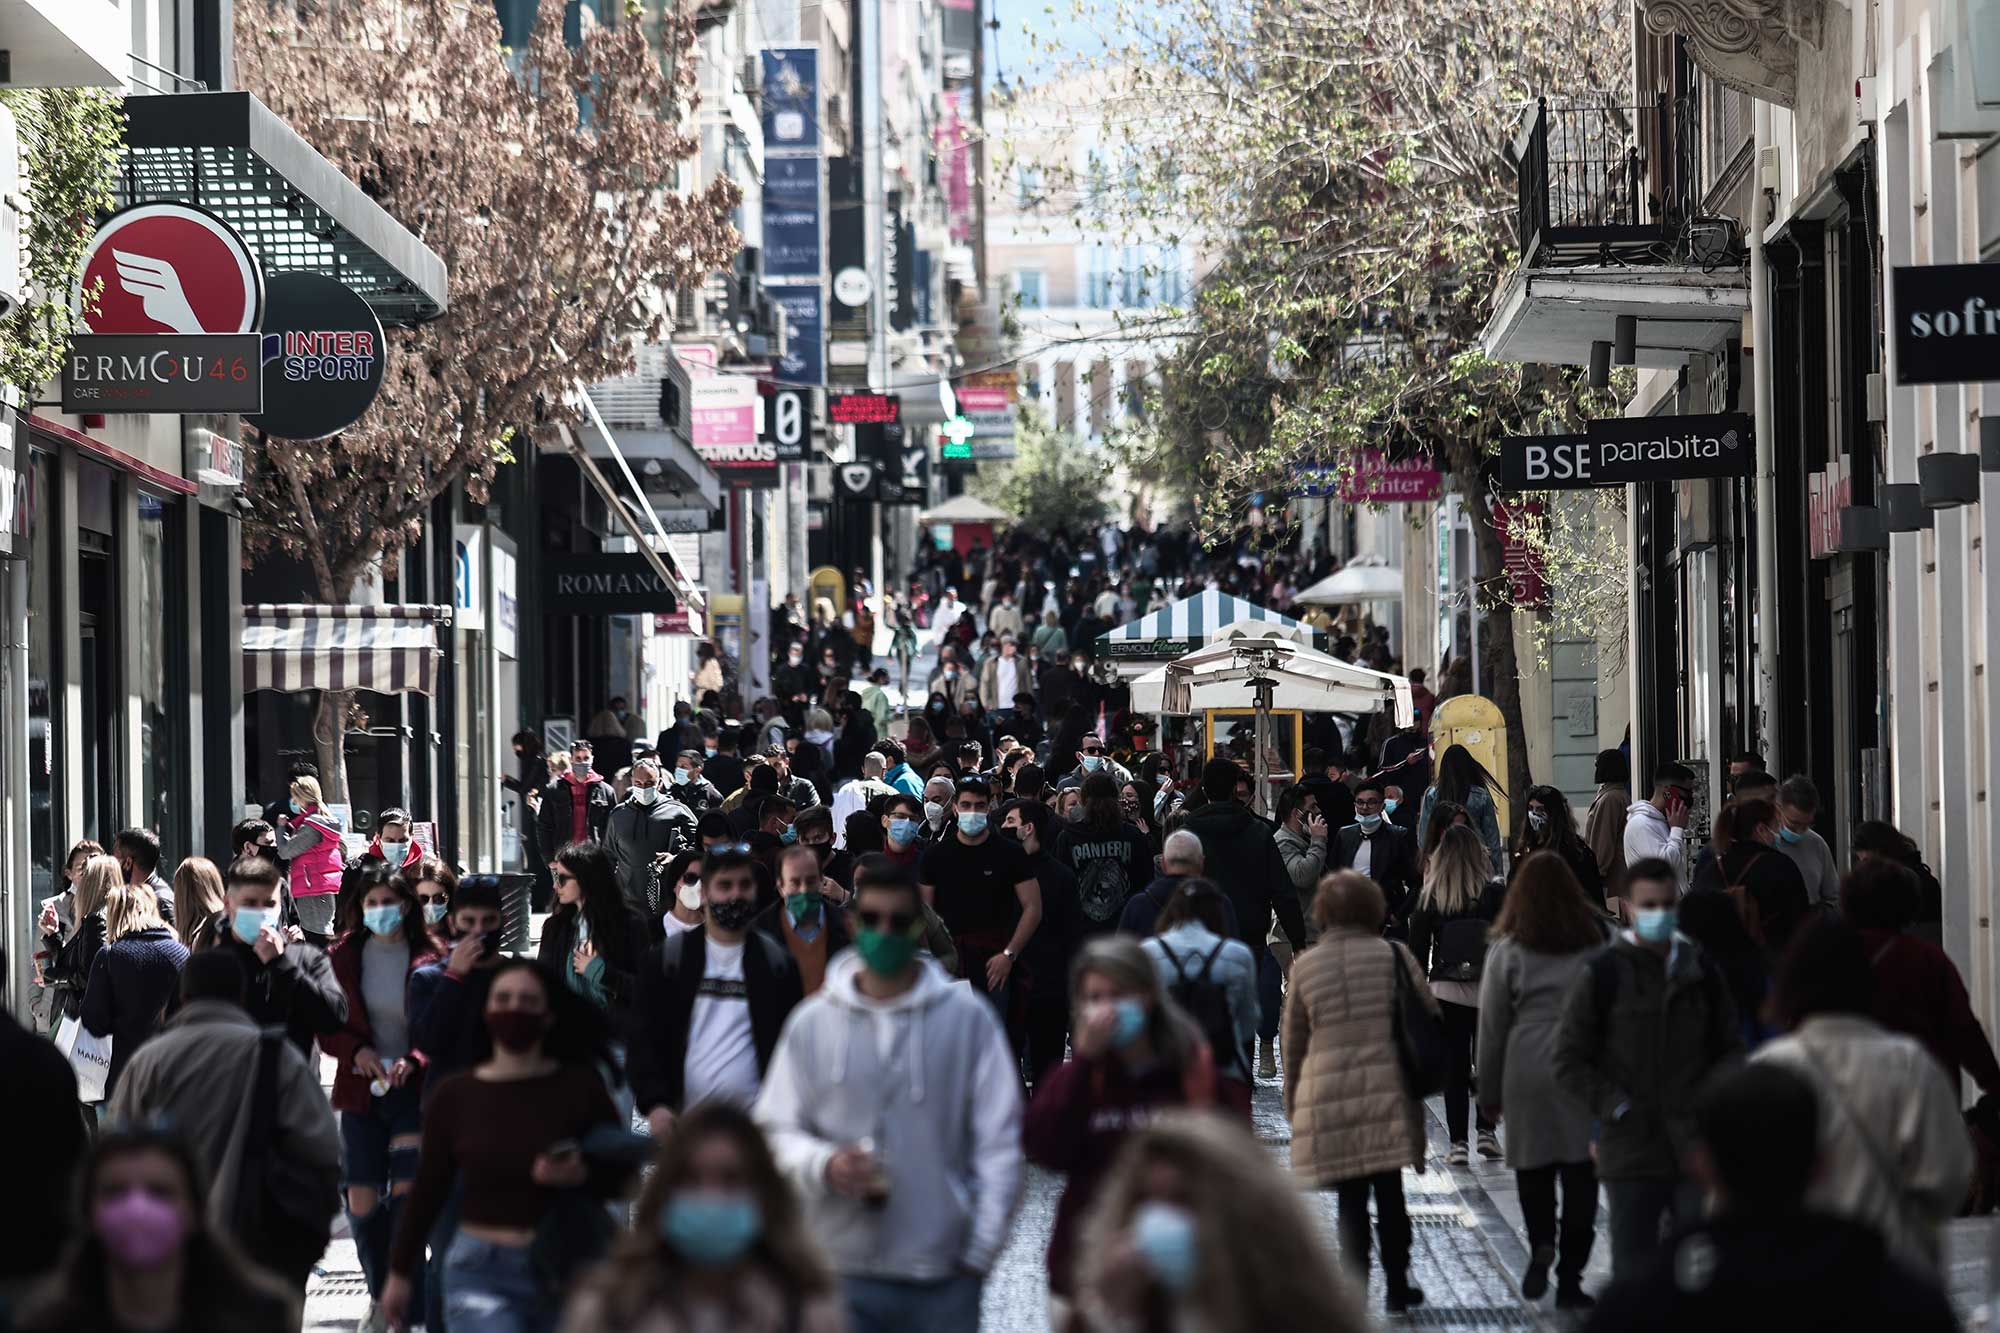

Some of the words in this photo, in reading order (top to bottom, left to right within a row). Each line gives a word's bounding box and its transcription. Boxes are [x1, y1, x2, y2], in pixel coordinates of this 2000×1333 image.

[285, 331, 375, 356] INTER
[284, 356, 375, 382] SPORT
[73, 387, 100, 399] CAFE
[1600, 434, 1720, 467] parabita
[1110, 644, 1151, 653] ERMOU
[1151, 639, 1188, 652] Flower
[1072, 840, 1132, 868] PANTERA
[77, 1047, 110, 1069] MANGO
